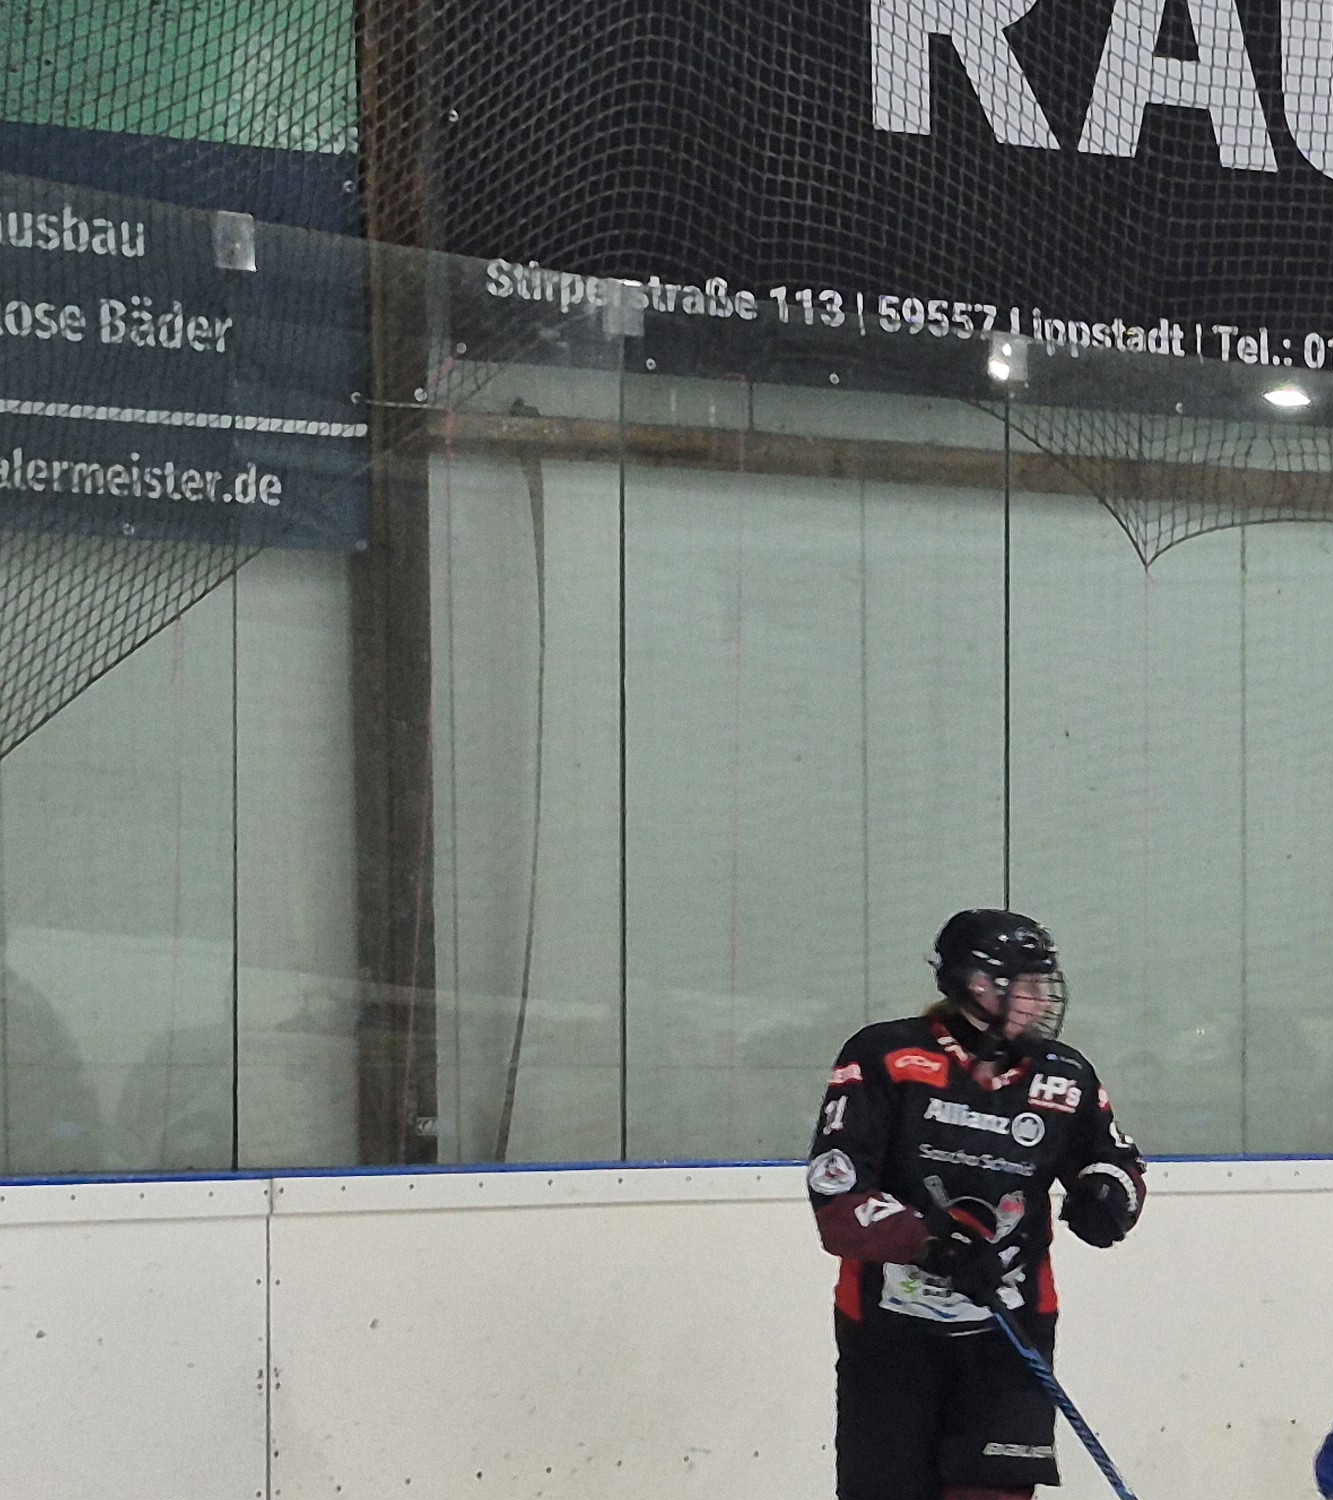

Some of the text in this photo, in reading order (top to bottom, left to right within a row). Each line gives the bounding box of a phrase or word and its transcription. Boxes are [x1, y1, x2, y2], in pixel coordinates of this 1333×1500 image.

[0, 203, 145, 258] usbau
[0, 295, 234, 353] ose Bäder
[769, 286, 843, 328] 113
[878, 294, 998, 341] 59557
[1212, 324, 1293, 367] Tel.:
